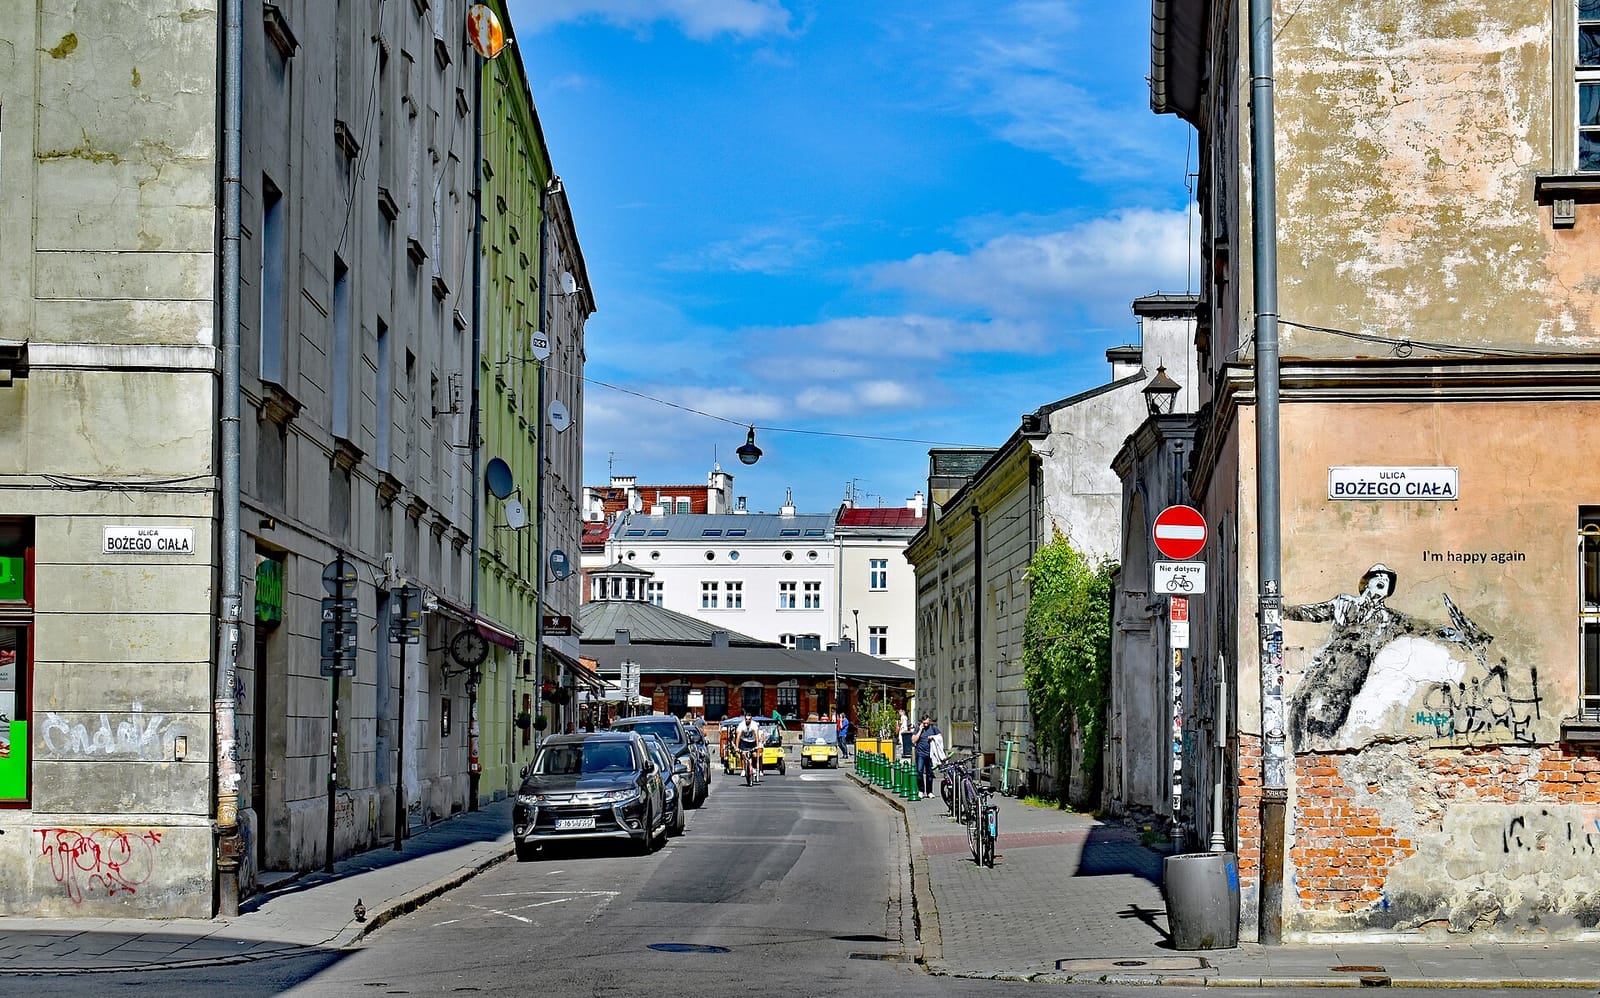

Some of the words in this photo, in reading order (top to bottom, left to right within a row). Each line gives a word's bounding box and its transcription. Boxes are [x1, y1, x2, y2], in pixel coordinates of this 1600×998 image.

[1379, 472, 1406, 480] ULICA
[1335, 479, 1401, 496] BOŻEGO
[1405, 482, 1453, 496] CIAŁA
[107, 536, 152, 550] BOŻEGO
[157, 538, 189, 551] CIAŁA
[1422, 551, 1443, 562] I'm
[1446, 550, 1487, 564] happy
[1490, 550, 1526, 564] again
[1174, 565, 1201, 573] dotyczy
